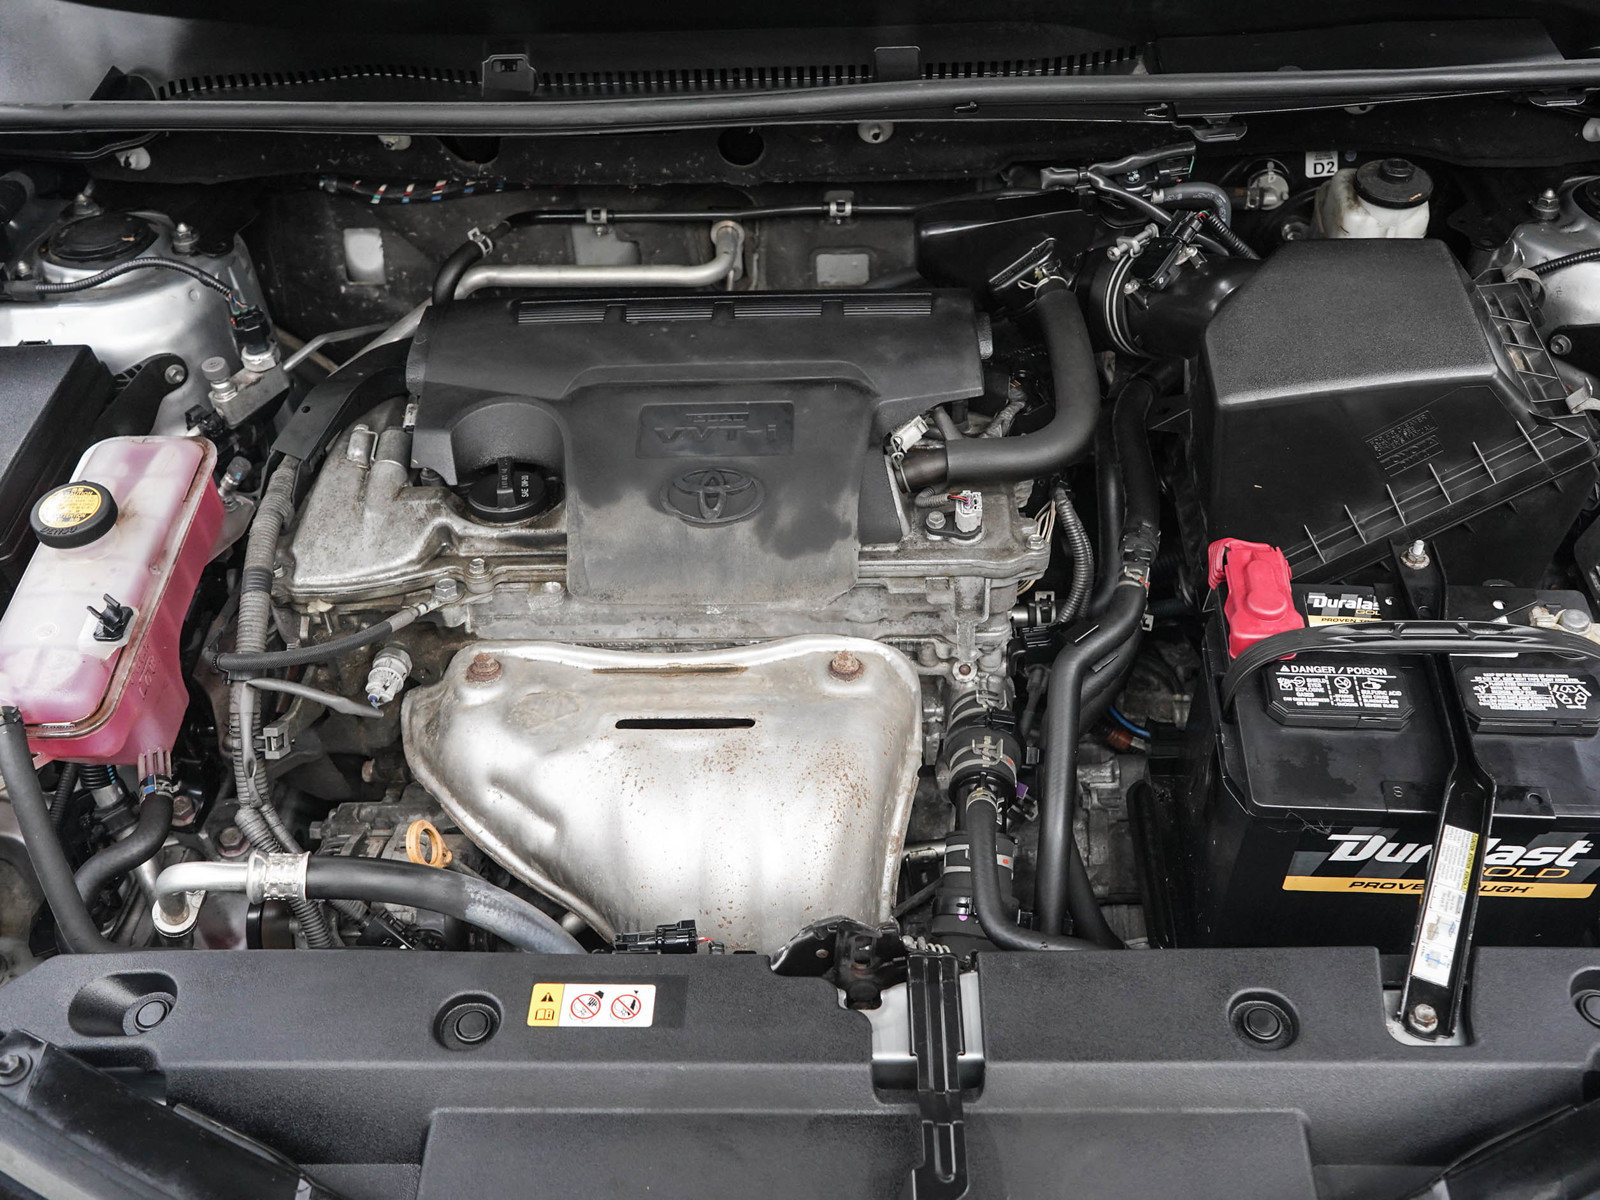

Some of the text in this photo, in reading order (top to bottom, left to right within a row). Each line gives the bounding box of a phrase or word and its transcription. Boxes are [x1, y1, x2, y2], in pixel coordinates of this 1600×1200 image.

[1314, 161, 1335, 175] D2
[1291, 665, 1336, 674] DANGER
[1346, 667, 1387, 676] POISON
[1483, 866, 1570, 879] OLD
[1348, 881, 1425, 891] PROVE
